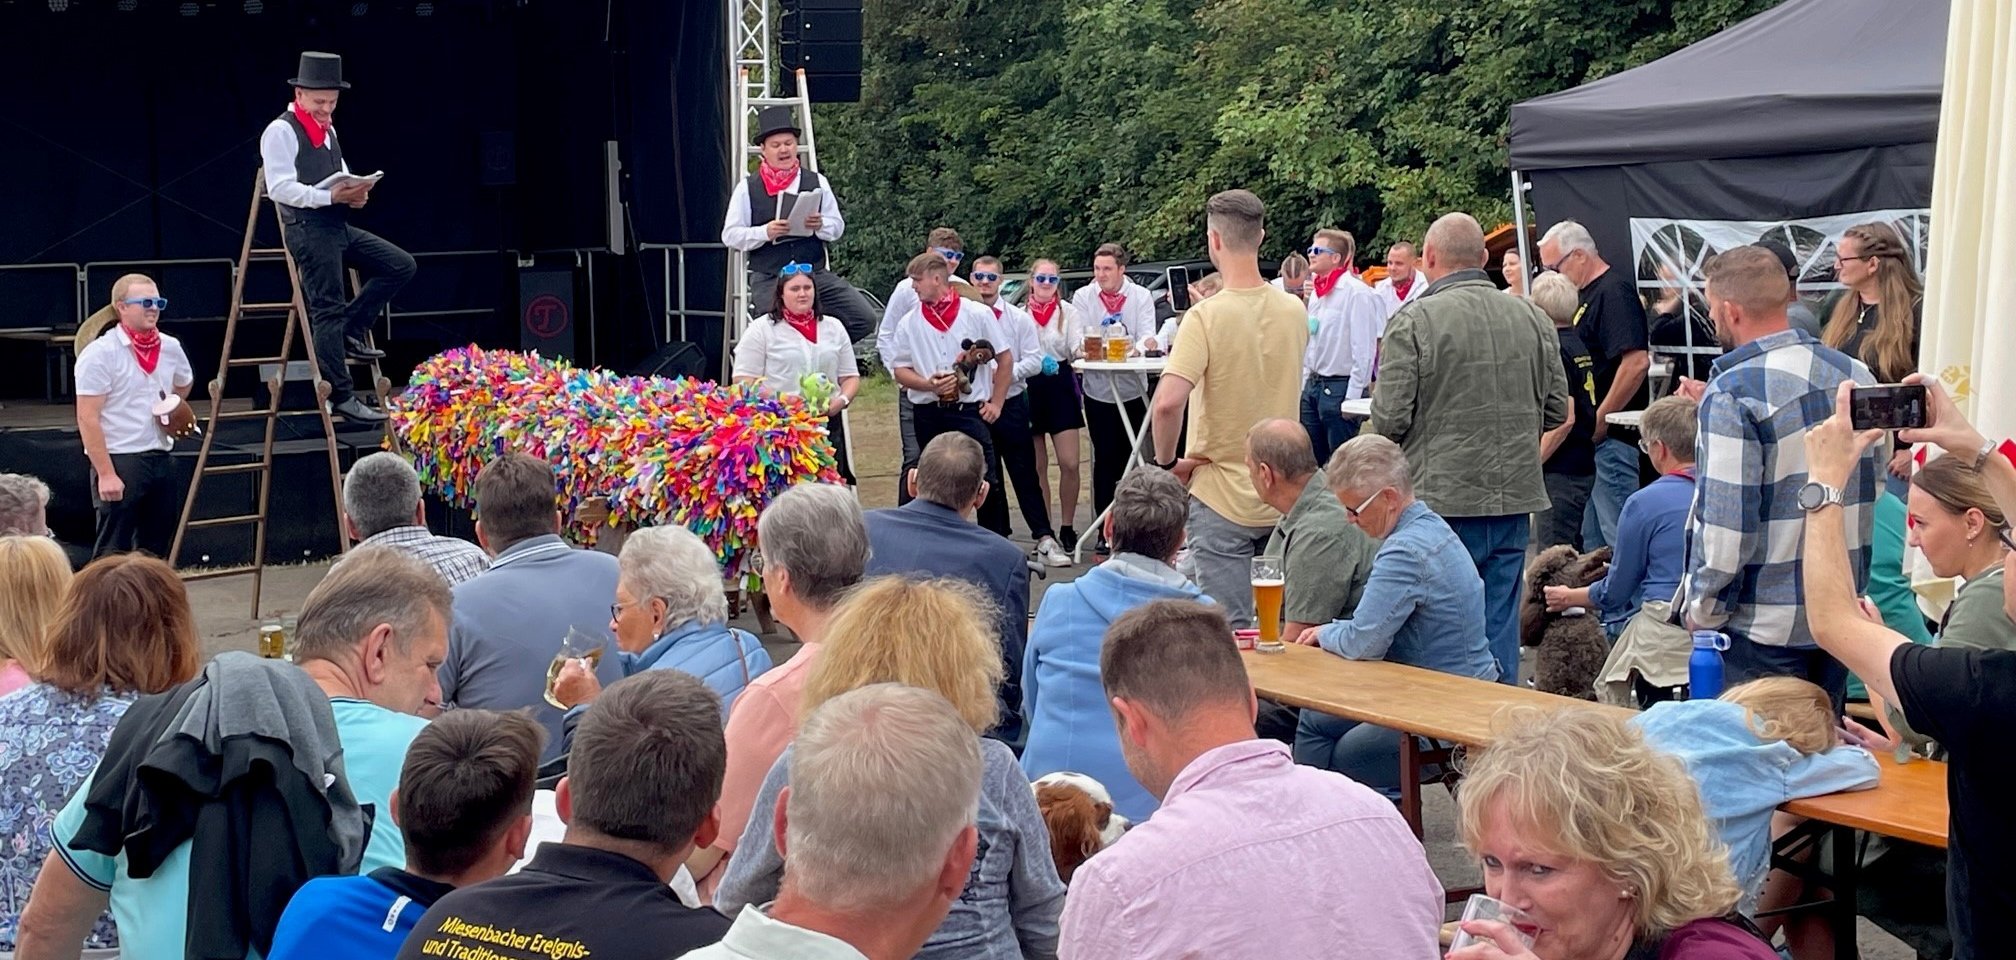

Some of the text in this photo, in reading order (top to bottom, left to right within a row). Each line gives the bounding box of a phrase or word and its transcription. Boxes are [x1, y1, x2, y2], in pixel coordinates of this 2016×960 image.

[422, 938, 517, 960] und Traditio
[437, 916, 591, 960] Miesenbacher Ereignis-
